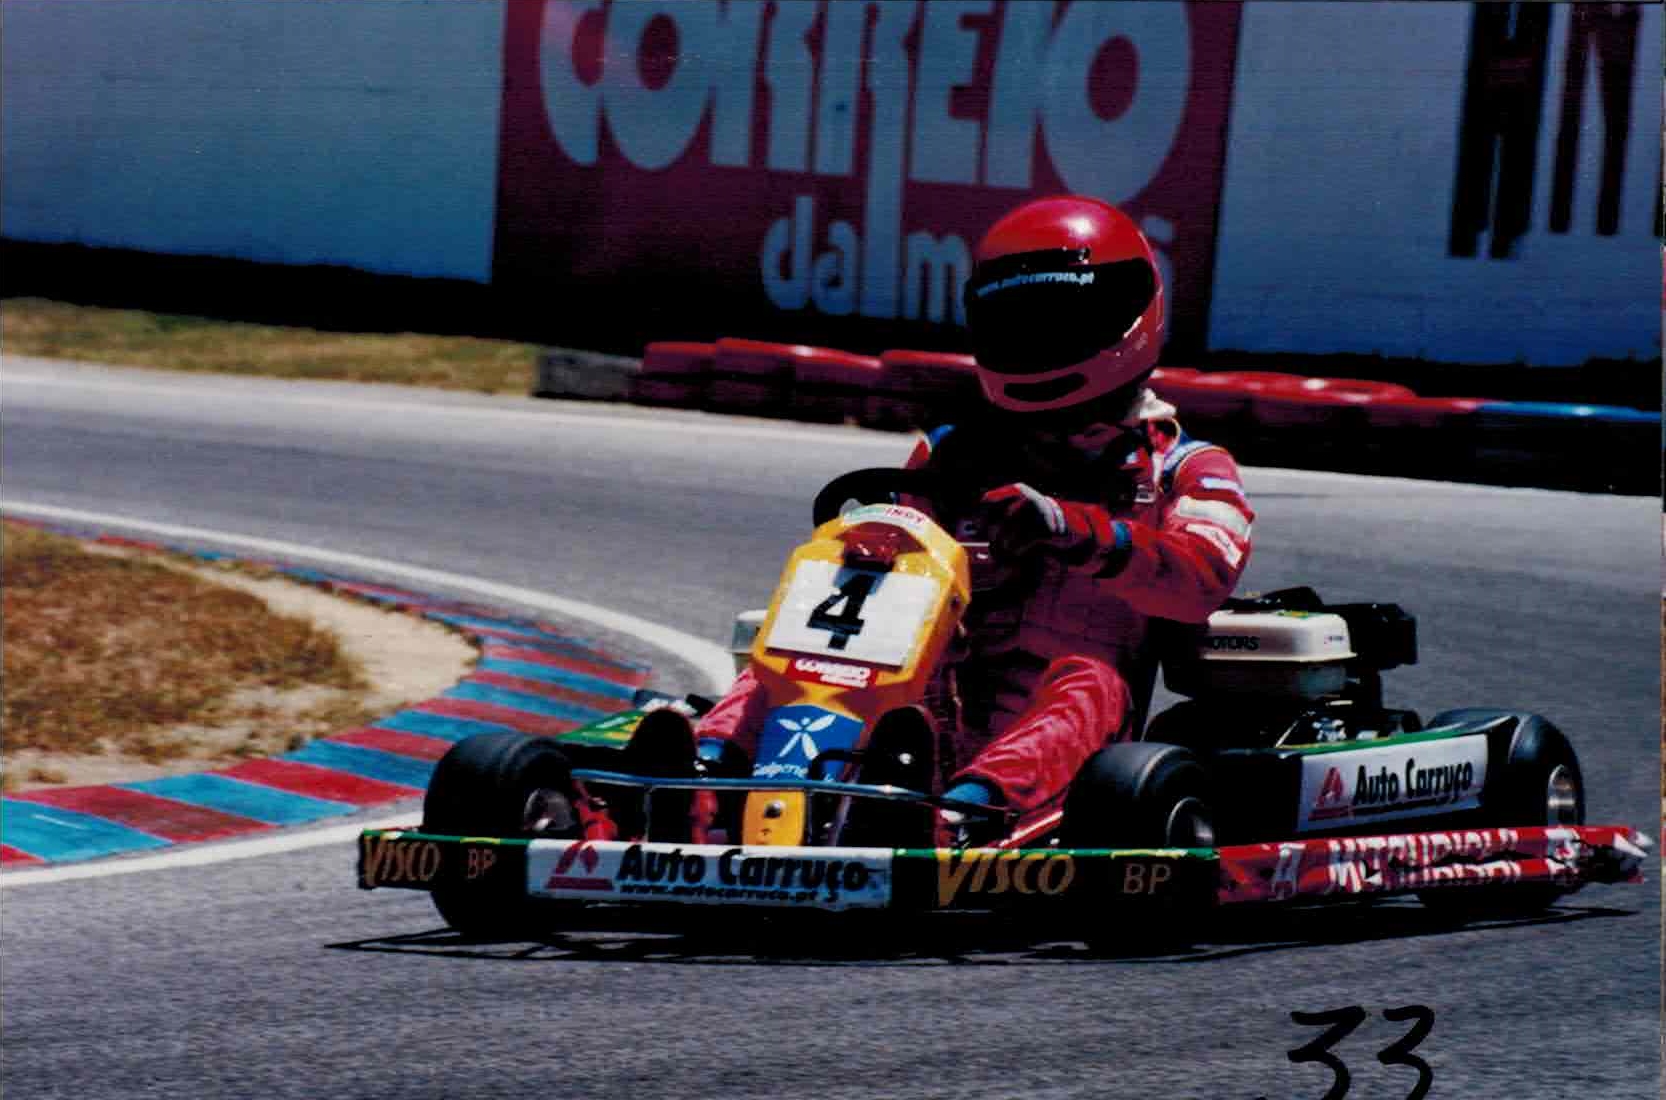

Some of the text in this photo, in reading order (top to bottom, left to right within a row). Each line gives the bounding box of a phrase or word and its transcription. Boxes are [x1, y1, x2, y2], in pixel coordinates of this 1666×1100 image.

[806, 569, 886, 650] 4
[1354, 764, 1398, 806] Auto
[363, 837, 497, 886] VISCO BP
[615, 844, 706, 883] Auto
[935, 848, 1172, 907] VISCO BP
